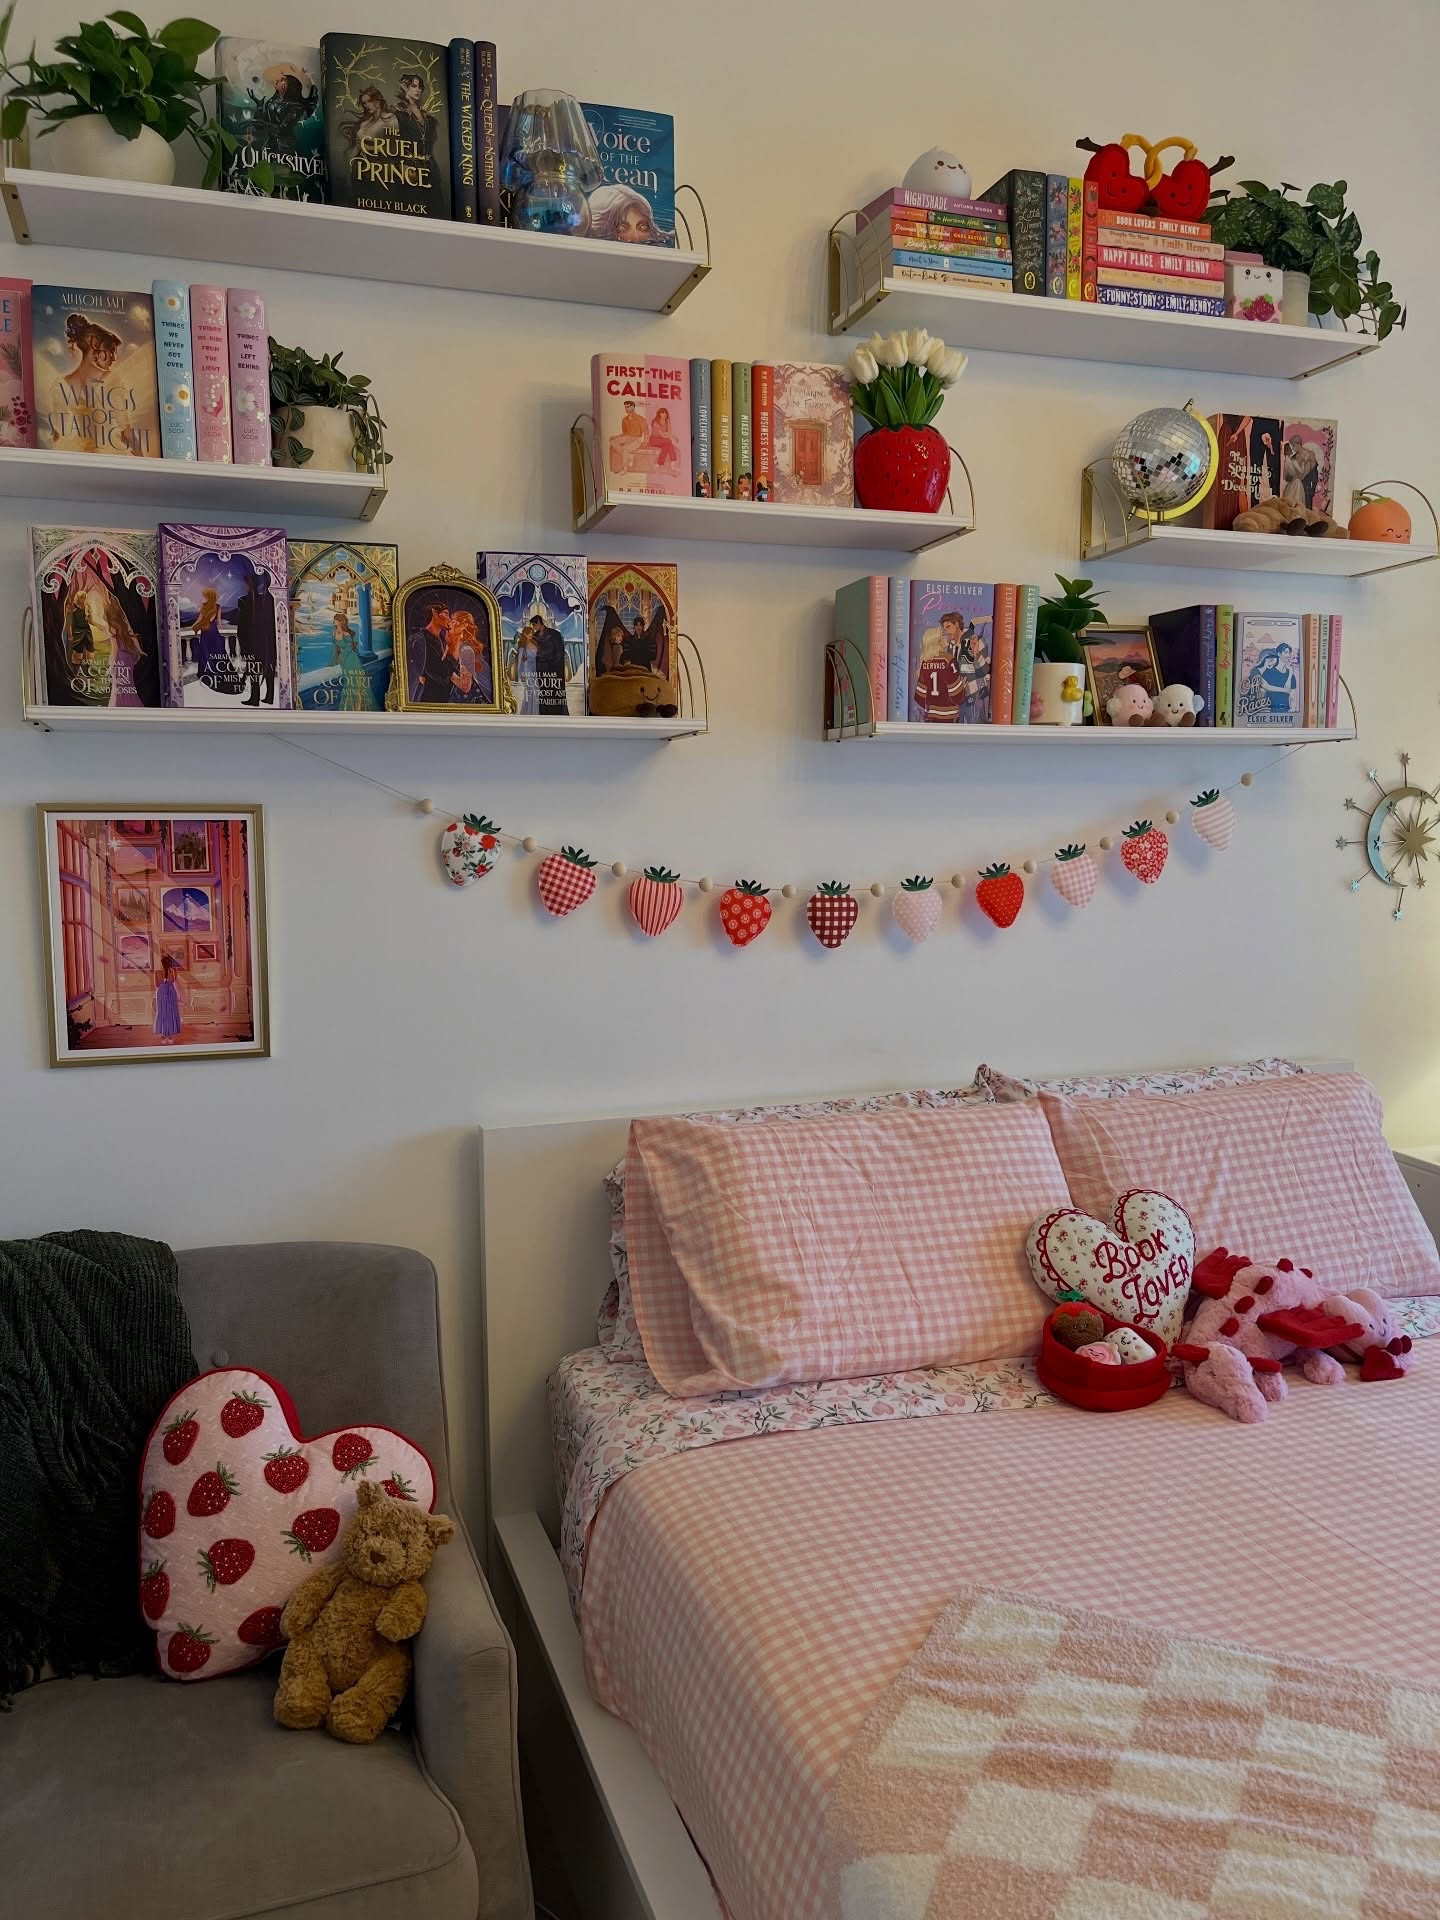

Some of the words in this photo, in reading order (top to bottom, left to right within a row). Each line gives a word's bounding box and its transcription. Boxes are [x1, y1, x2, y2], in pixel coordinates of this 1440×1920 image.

[461, 82, 472, 101] THE
[461, 104, 473, 152] WICKED
[480, 99, 495, 135] QUEEN
[384, 127, 401, 137] THE
[588, 122, 651, 154] Voice
[360, 136, 426, 161] CRUEL
[600, 152, 615, 162] OF
[618, 154, 641, 166] THE
[350, 157, 433, 192] PRINCE
[459, 153, 474, 187] KING
[484, 143, 495, 189] NOTHING
[601, 166, 658, 191] cean
[357, 197, 393, 210] HOLLY
[395, 202, 428, 215] BLACK
[904, 190, 948, 211] NIGHTSHADE
[1116, 215, 1133, 226] BOOK
[1134, 217, 1156, 230] LOVERS
[1159, 221, 1179, 232] EMILY
[1181, 223, 1201, 236] HENRY
[1103, 248, 1128, 263] HAPPY
[1130, 252, 1154, 268] PLACE
[1160, 256, 1183, 271] EMILY
[1186, 259, 1211, 275] HENRY
[1106, 289, 1130, 304] FUNNY
[1133, 292, 1157, 308] STORY
[1165, 296, 1187, 311] EMILY
[1189, 299, 1213, 314] HENRY
[161, 321, 185, 330] THINGS
[164, 341, 186, 349] NEVER
[166, 361, 184, 369] OVER
[606, 365, 682, 382] FIRST-TIME
[59, 382, 137, 412] WINGS
[606, 380, 683, 401] CALLER
[48, 412, 92, 438] STAR
[91, 409, 116, 425] OF
[698, 405, 708, 442] LOVELIGHT
[741, 414, 750, 436] MIXED
[760, 411, 769, 446] BUSINESS
[699, 442, 708, 468] FARMS
[741, 438, 750, 468] SIGNALS
[760, 447, 769, 476] CASUAL
[926, 584, 951, 595] ELSIE
[953, 585, 983, 597] SILVER
[1005, 587, 1013, 610] ELSIE
[1027, 587, 1036, 610] ELSIE
[1004, 612, 1013, 640] SILVER
[1025, 612, 1035, 640] SILVER
[88, 666, 131, 678] COURT
[204, 661, 217, 674] A
[215, 660, 263, 674] COURT
[922, 662, 946, 670] GERVAIS
[950, 662, 958, 674] 1
[200, 674, 223, 689] OF
[526, 677, 564, 690] COURT
[929, 671, 940, 696] 1
[313, 688, 340, 705] OF
[1237, 696, 1272, 716] Races
[1247, 715, 1267, 723] ELSIE
[1269, 715, 1294, 724] SILVER
[1094, 1229, 1170, 1284] BOOK
[1121, 1254, 1191, 1324] LOVER
